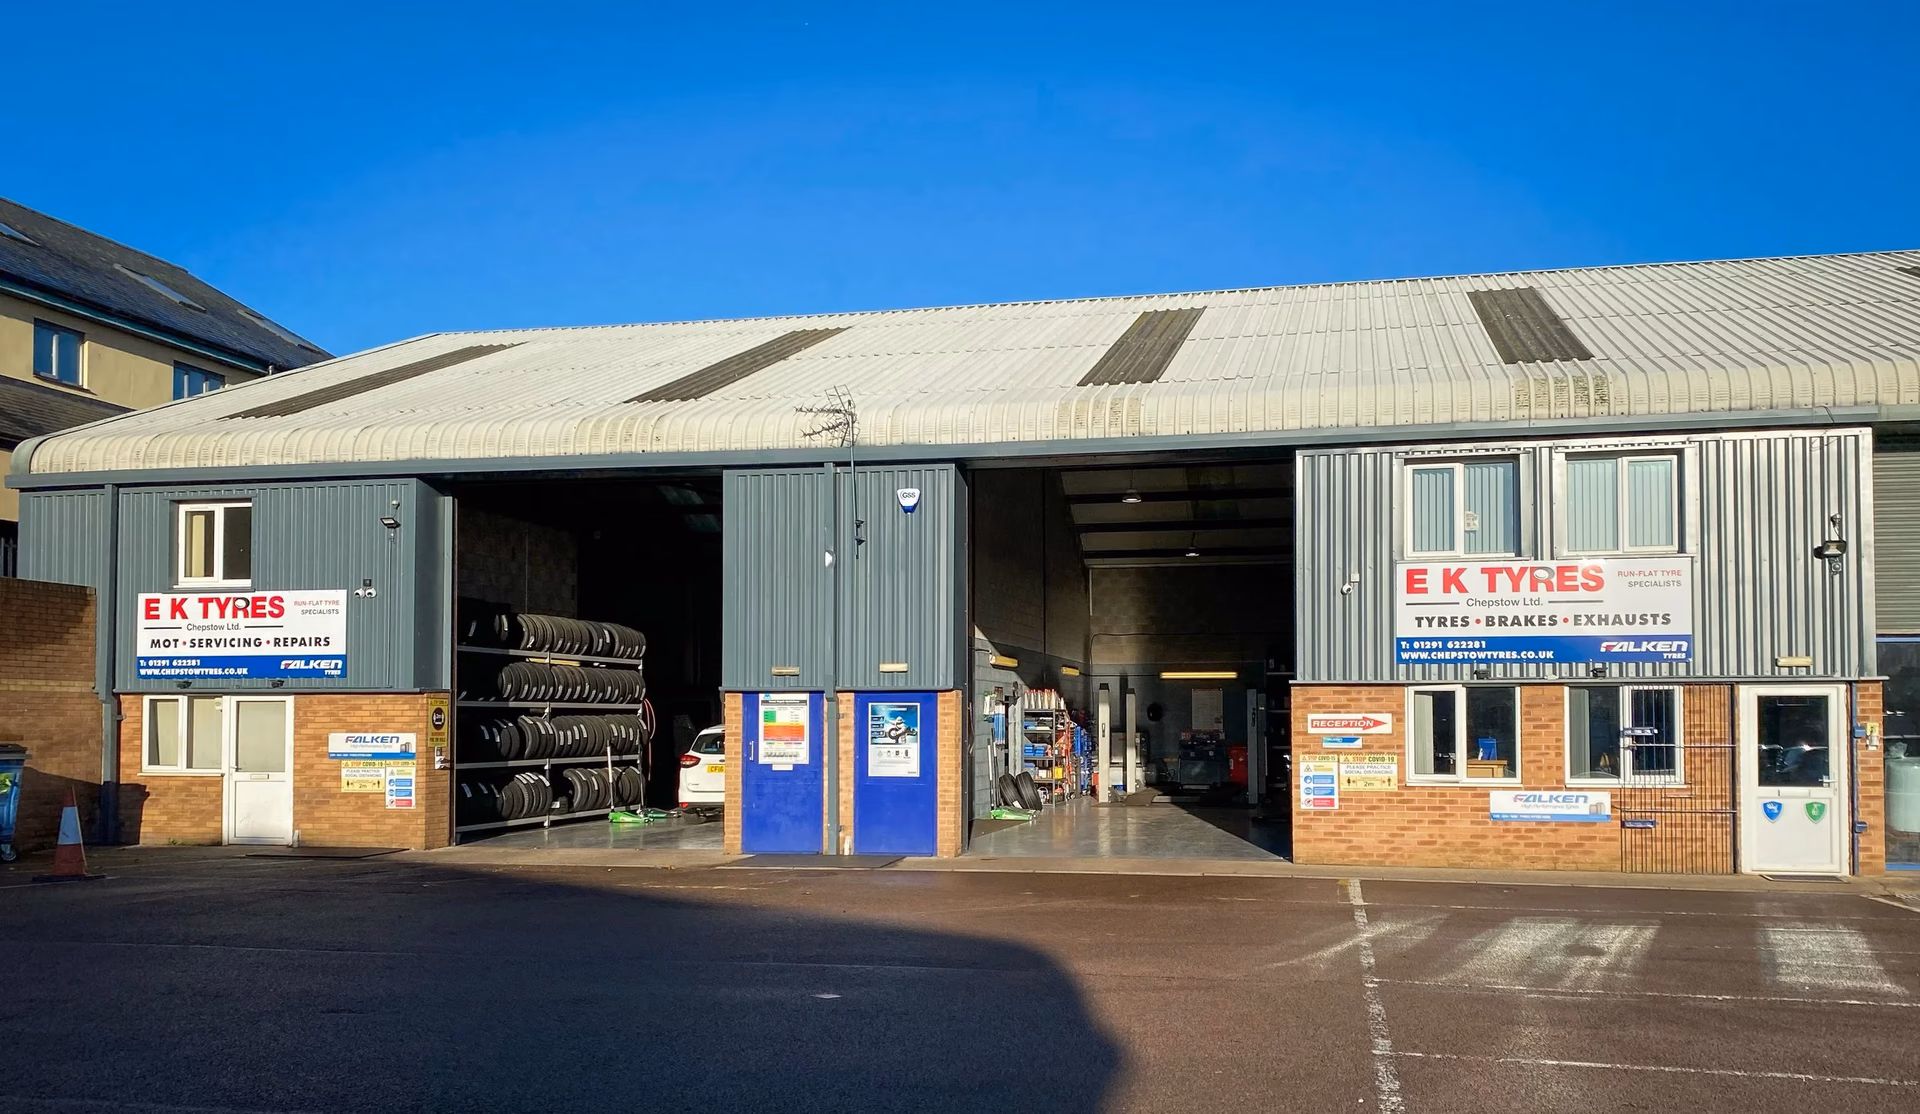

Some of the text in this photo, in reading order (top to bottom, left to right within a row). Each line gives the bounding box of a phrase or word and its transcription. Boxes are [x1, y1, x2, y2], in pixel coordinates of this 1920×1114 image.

[1617, 570, 1659, 578] RUN-FLAT
[1406, 565, 1605, 594] E K TYRES
[1628, 580, 1682, 588] SPECIALISTS
[1466, 597, 1544, 608] Chepstow Ltd.
[145, 595, 285, 620] E K TYRES
[301, 608, 339, 616] SPECIALISTS
[1415, 613, 1672, 628] TYRES BRAKES EXHAUSTS
[186, 623, 241, 632] Chepstow Ltd.
[150, 636, 331, 648] MOT SERVICING REPAIRS
[1401, 640, 1486, 649] T: 01291 622281
[1600, 640, 1689, 653] FALKEN
[1400, 650, 1555, 660] WWW.CHEPSTOWTYRES.CO.UK
[1662, 652, 1686, 660] TYRES
[139, 659, 201, 667] T: 01291 622281
[280, 659, 343, 670] FALKEN
[139, 667, 248, 676] WWW.CHEPSTOWTYRES.CO.UK
[1312, 719, 1374, 727] RECEPTION
[1513, 794, 1589, 804] FALKEN
